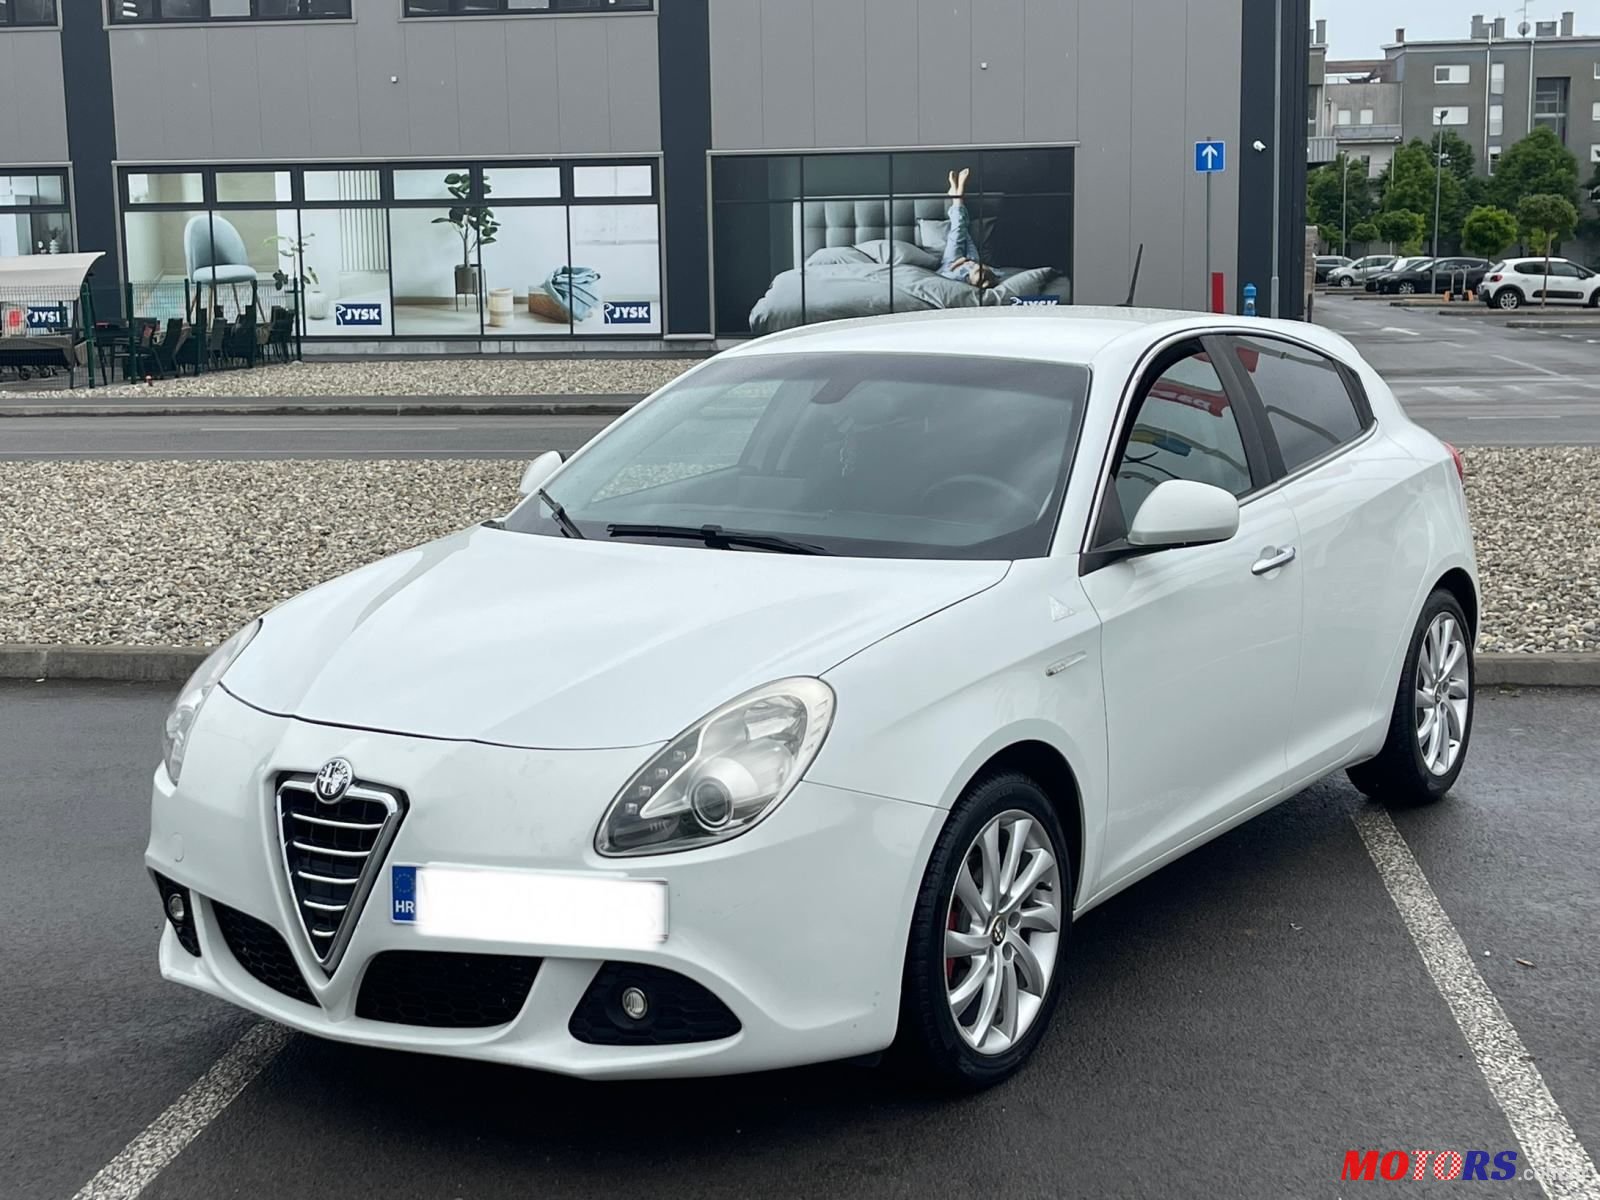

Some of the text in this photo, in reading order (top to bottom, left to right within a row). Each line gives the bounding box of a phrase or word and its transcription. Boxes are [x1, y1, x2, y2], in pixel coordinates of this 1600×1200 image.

[344, 308, 380, 320] JYSK
[613, 306, 649, 318] JYSK
[395, 900, 415, 914] HR
